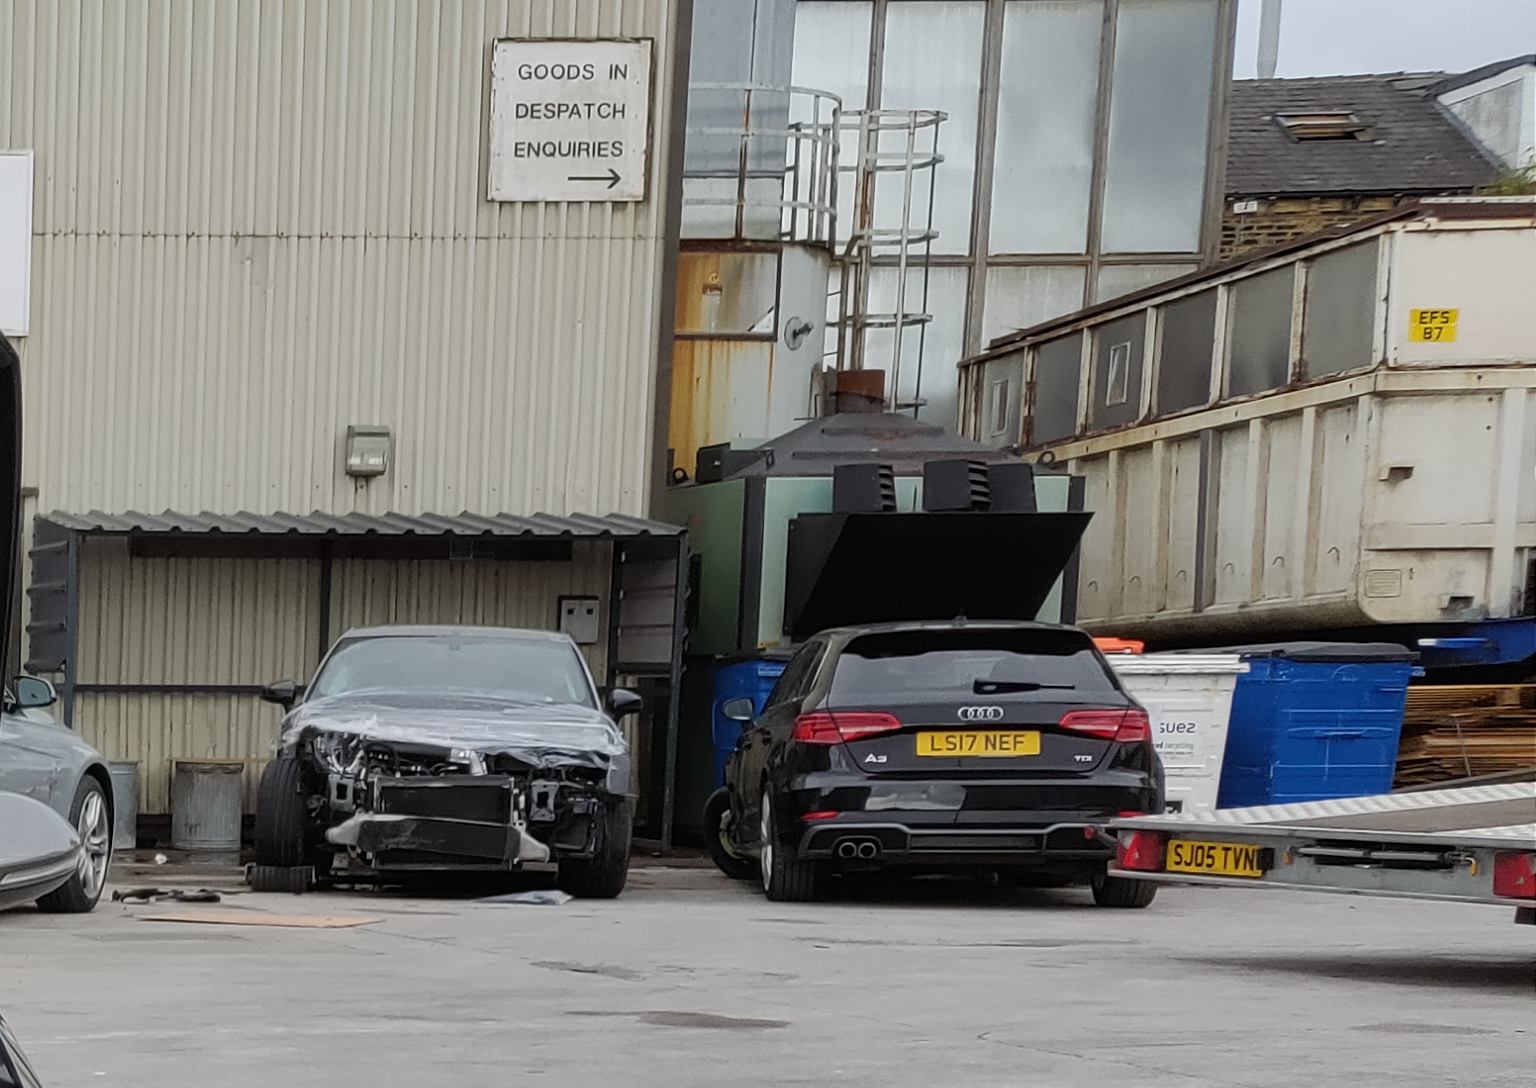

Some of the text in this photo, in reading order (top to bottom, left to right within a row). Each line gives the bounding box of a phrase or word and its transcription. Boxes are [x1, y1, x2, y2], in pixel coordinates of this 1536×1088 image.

[518, 63, 628, 80] GOODS IN
[515, 103, 626, 120] DESPATCH
[514, 141, 624, 158] ENQUIRIES
[1419, 310, 1450, 324] EFS
[930, 734, 1024, 752] LS17 NEF
[1174, 843, 1217, 868] SJ05
